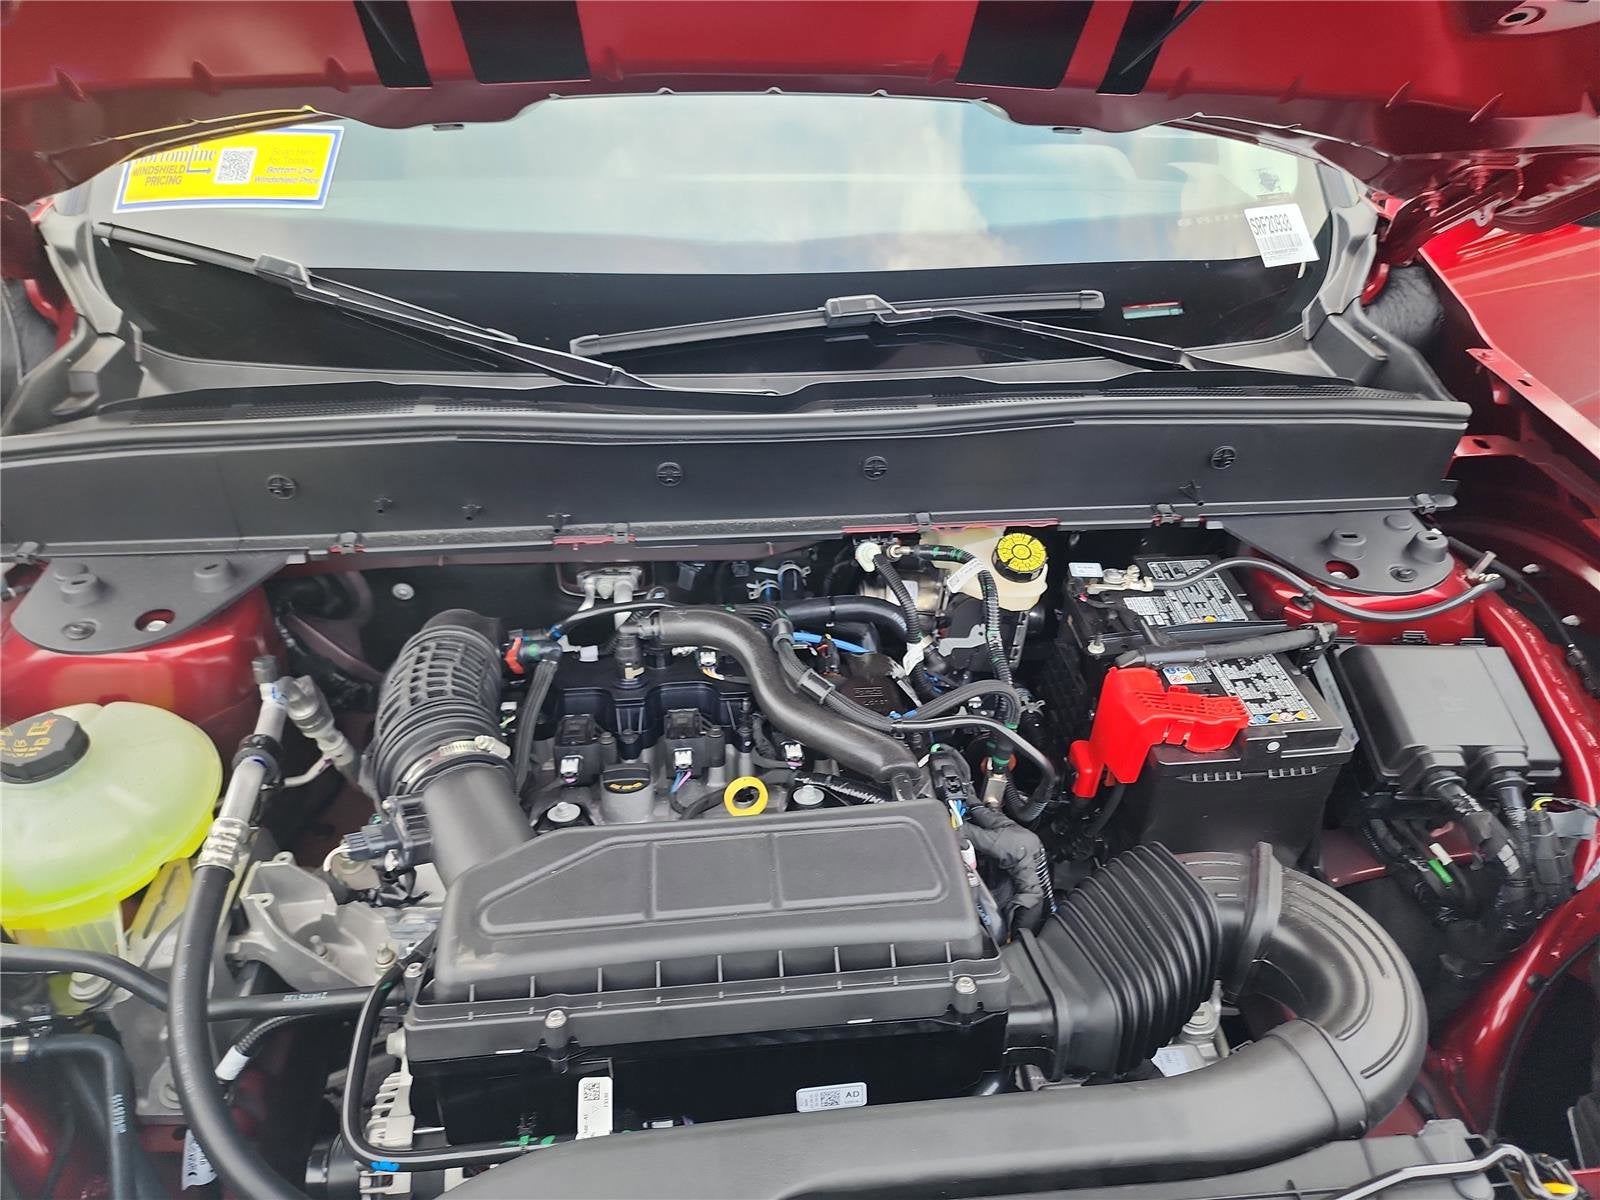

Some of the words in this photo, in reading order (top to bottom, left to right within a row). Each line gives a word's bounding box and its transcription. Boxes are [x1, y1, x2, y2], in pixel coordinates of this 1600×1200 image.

[133, 164, 187, 177] WINDSHIELD
[144, 175, 183, 187] PRICING
[845, 1090, 860, 1098] AD
